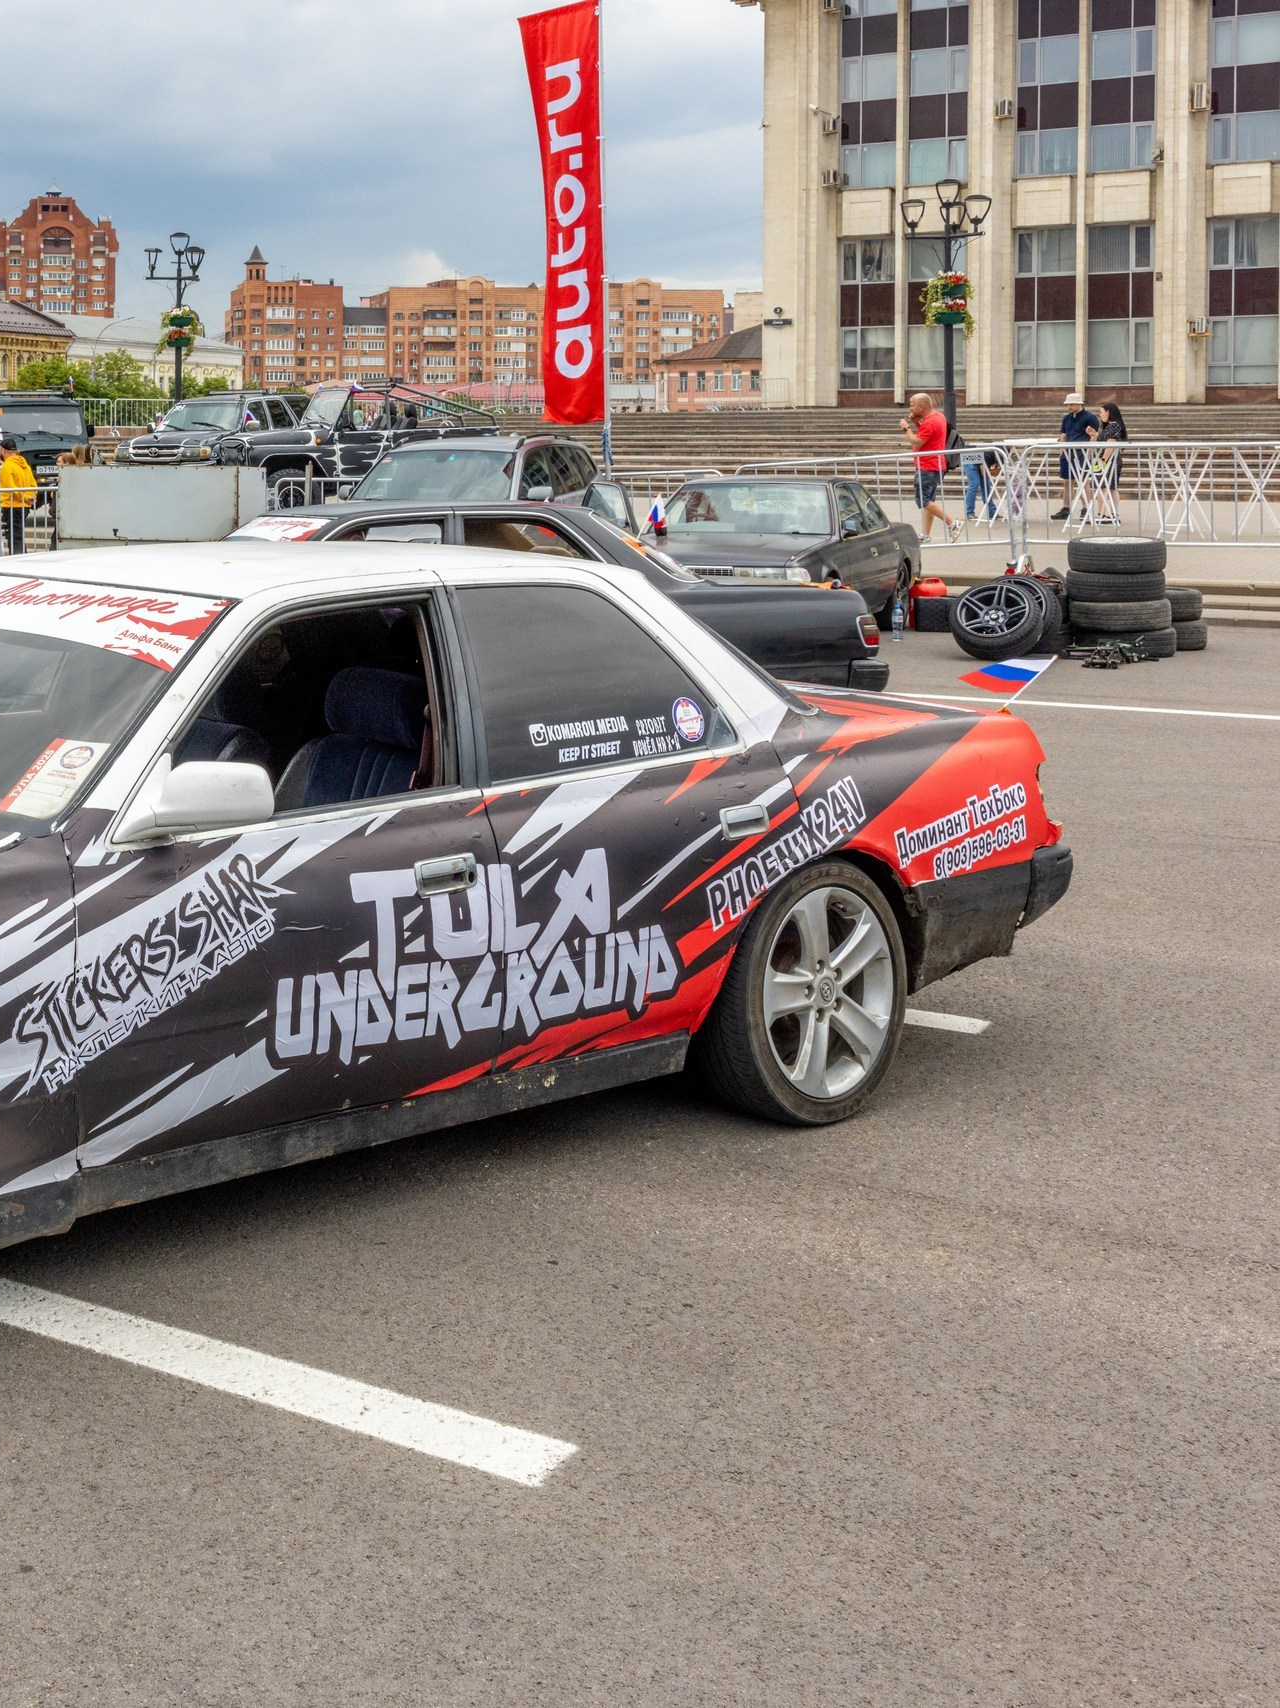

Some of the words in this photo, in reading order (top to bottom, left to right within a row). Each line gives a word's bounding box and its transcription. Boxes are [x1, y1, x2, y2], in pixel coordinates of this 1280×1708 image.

[534, 58, 594, 379] auto.ru
[118, 629, 154, 646] Альфа
[154, 637, 184, 655] Банк
[31, 749, 55, 772] 2025
[546, 715, 629, 742] KOMAROV.MEDIA
[558, 744, 581, 764] KEEP
[581, 744, 591, 760] IT
[590, 740, 621, 760] STREET
[894, 808, 969, 869] Доминант
[966, 783, 1027, 829] ТехБокс
[933, 815, 1027, 879] 8(903)596-03-31
[350, 847, 611, 1000] TULA
[275, 924, 679, 1065] UNDERGROUND
